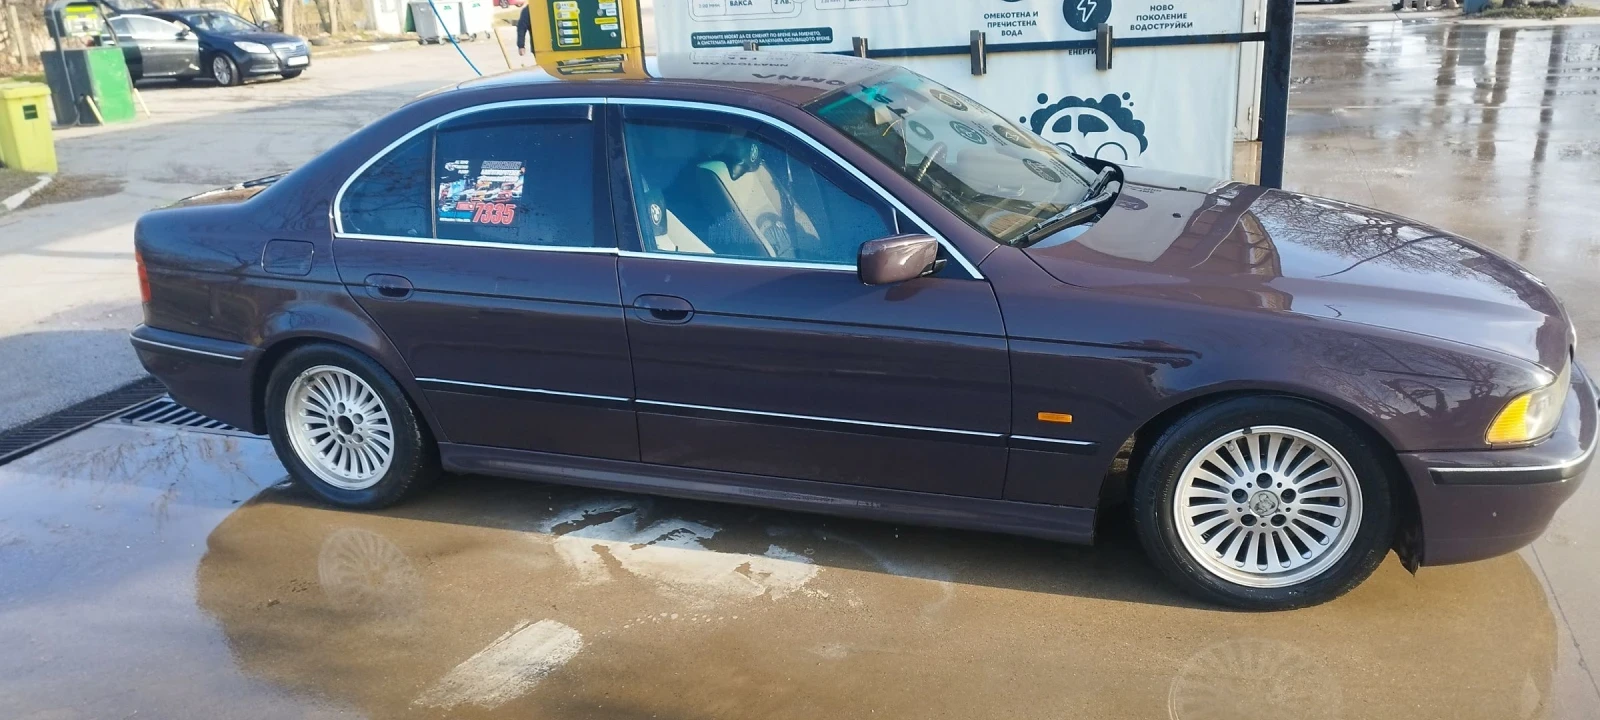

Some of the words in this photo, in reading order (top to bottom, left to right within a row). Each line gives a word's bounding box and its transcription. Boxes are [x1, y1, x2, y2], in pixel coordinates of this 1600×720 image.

[1136, 13, 1187, 21] ПОКОЛЕНИЕ
[987, 20, 1037, 28] ПРЕЧИСТЕНА
[1130, 21, 1193, 31] ВОДОСТРУЙКИ
[472, 202, 517, 224] 7335
